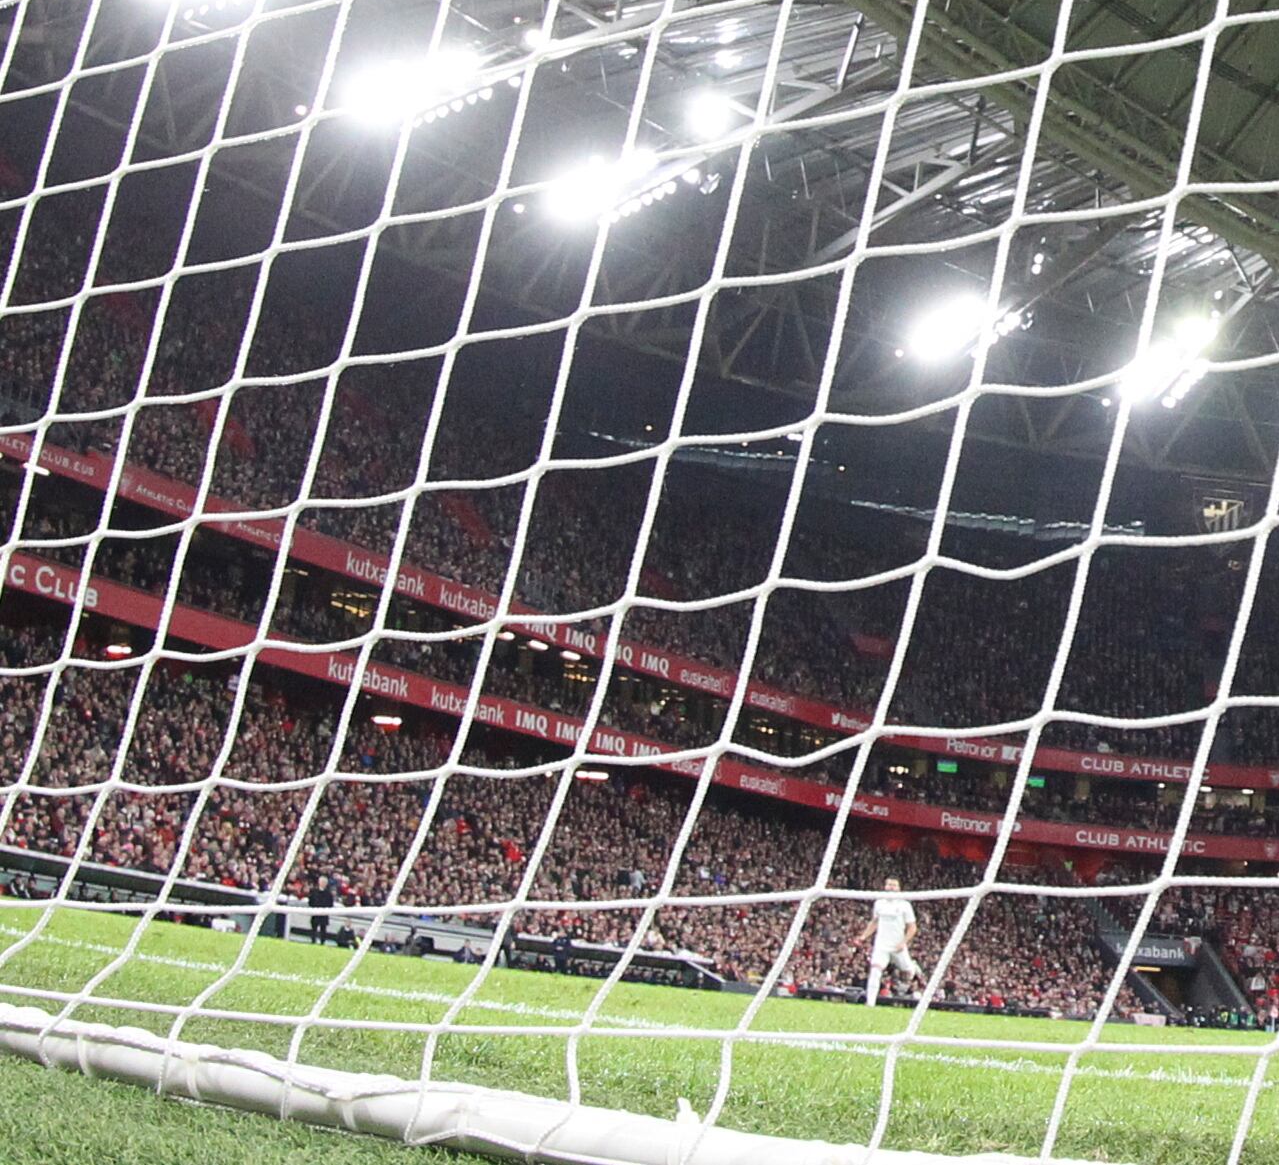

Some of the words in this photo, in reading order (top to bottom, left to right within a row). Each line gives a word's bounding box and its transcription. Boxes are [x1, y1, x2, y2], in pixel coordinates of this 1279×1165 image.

[35, 566, 98, 606] CLUB
[346, 551, 425, 596] kutxaank
[439, 584, 497, 620] kutxaba
[565, 628, 596, 654] IMQ
[641, 654, 670, 676] IMQ
[328, 657, 408, 698] kutabank
[516, 710, 548, 737] IMQ
[595, 732, 626, 757] IMQ
[1081, 756, 1124, 773] CLUB
[1131, 762, 1210, 781] ATHLETC
[941, 812, 992, 834] Petronor
[1076, 830, 1119, 846] CLUB
[1126, 835, 1206, 854] ATHLTIC
[1116, 942, 1184, 959] kxabank
